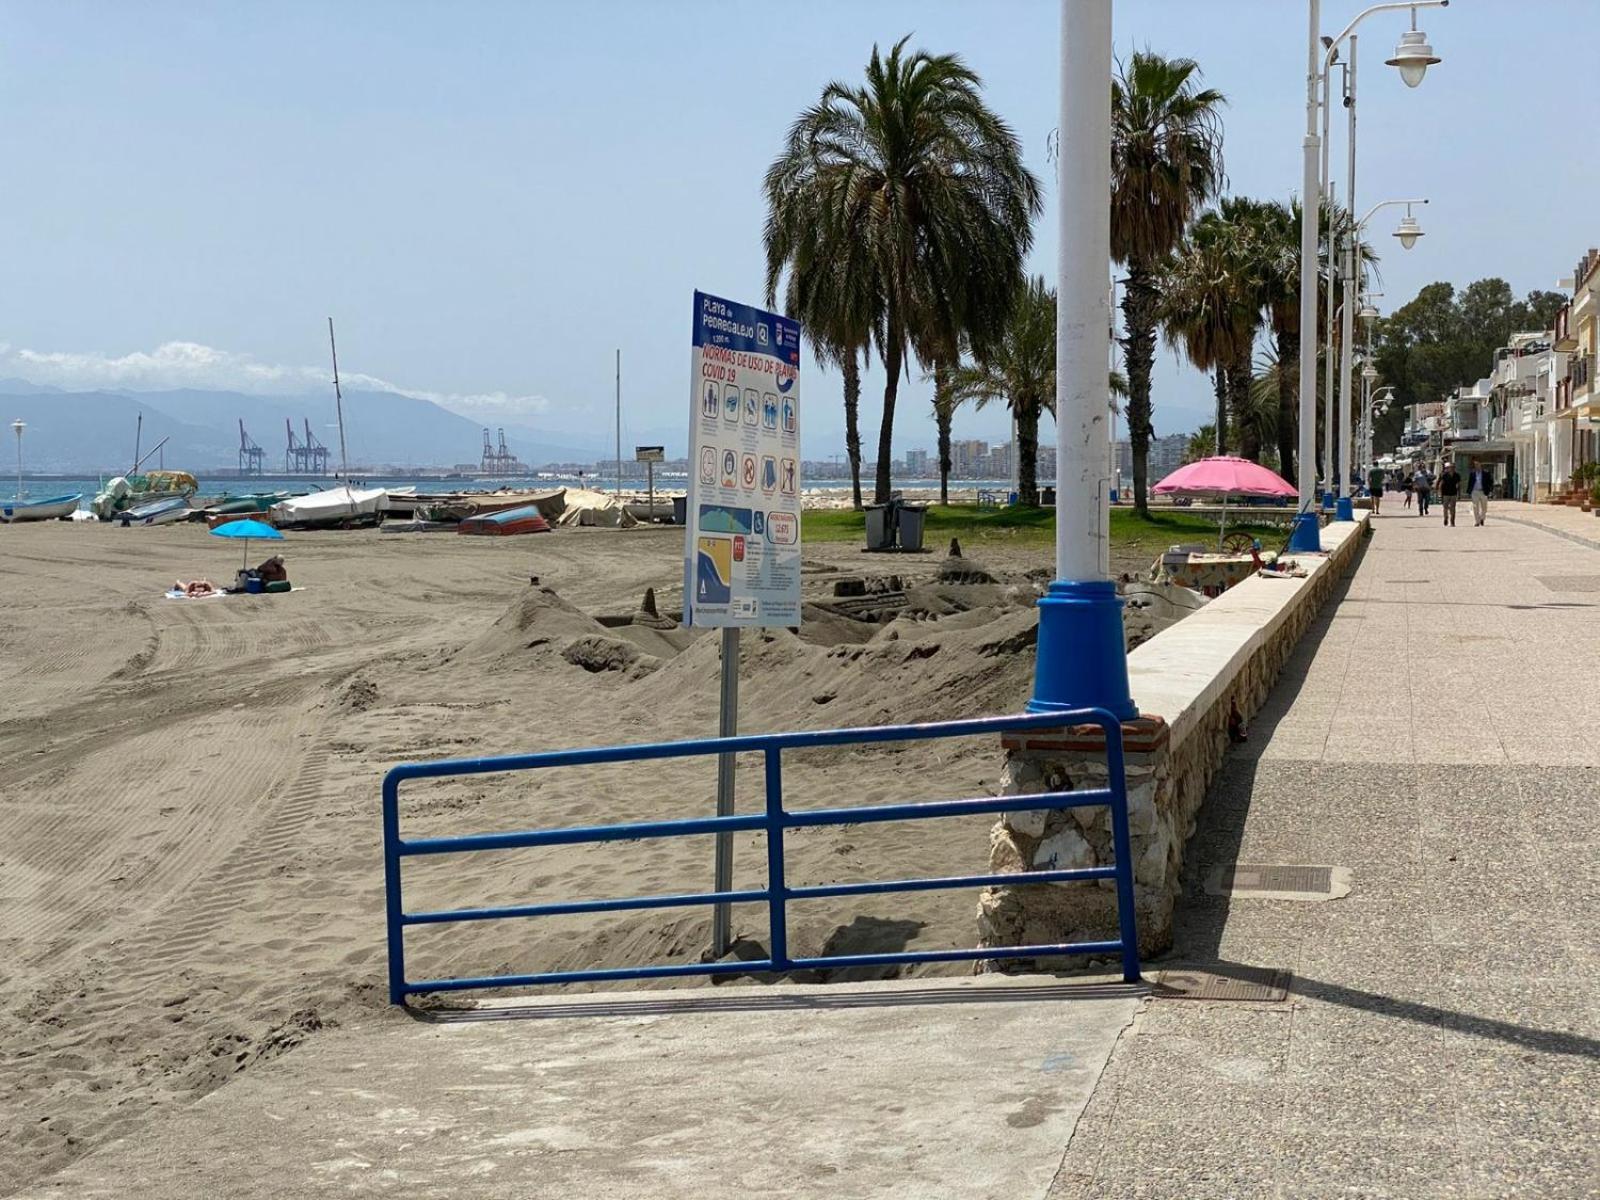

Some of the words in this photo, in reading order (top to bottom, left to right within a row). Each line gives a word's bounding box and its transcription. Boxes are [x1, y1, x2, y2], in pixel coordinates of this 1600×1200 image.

[703, 343, 737, 365] NORMAS
[737, 352, 747, 368] DE
[748, 355, 764, 371] USO
[764, 359, 774, 374] DE
[702, 362, 726, 380] COVID
[727, 367, 736, 382] 19
